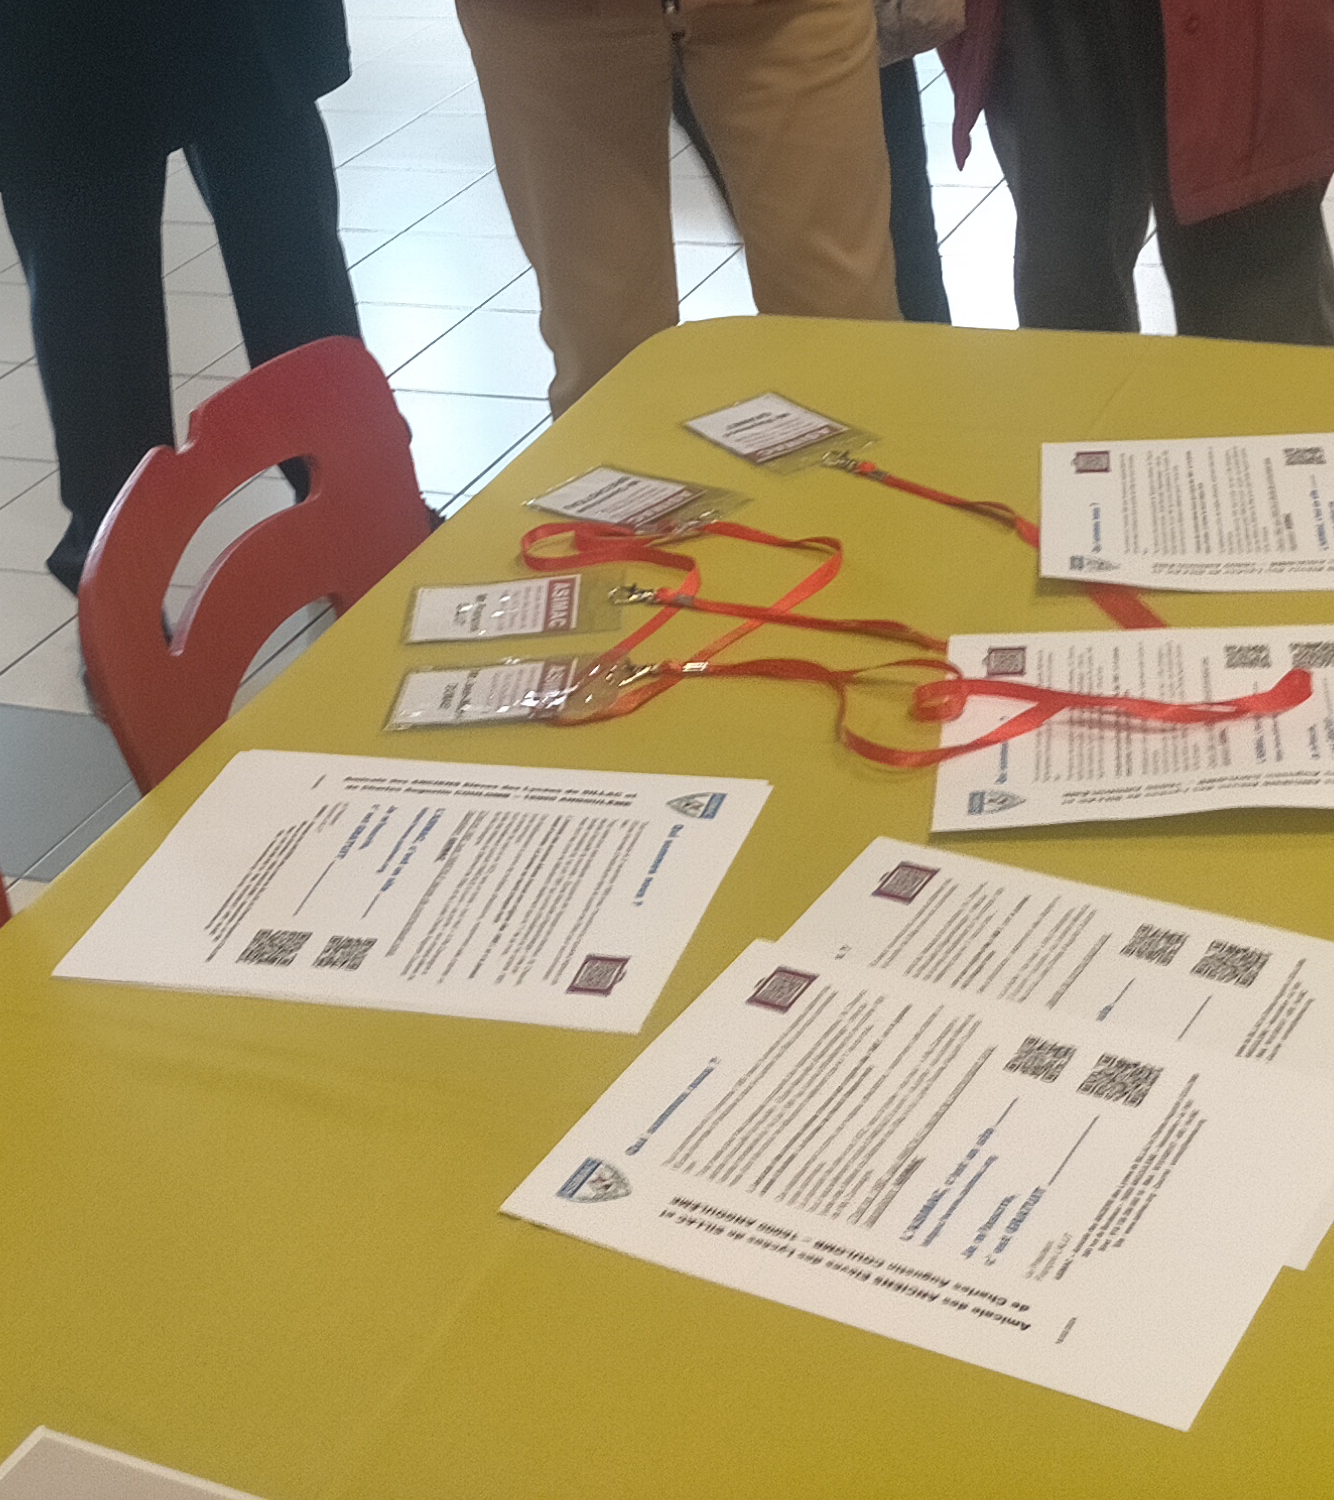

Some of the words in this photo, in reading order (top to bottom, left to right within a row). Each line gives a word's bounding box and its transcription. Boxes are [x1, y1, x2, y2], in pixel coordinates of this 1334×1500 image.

[547, 581, 570, 628] ASIMAC
[666, 824, 685, 838] Qui
[646, 840, 674, 874] sommes
[634, 877, 654, 898] nous
[657, 1208, 677, 1220] et
[673, 1213, 727, 1236] SILLAC
[724, 1228, 746, 1241] de
[793, 1250, 824, 1266] des
[810, 1238, 886, 1268] COULOMB
[884, 1260, 952, 1289] Augustin
[870, 1274, 941, 1303] ANCIENS
[949, 1282, 1009, 1307] Charles
[939, 1296, 968, 1311] des
[1008, 1300, 1030, 1313] de
[967, 1305, 1032, 1332] Amicale
